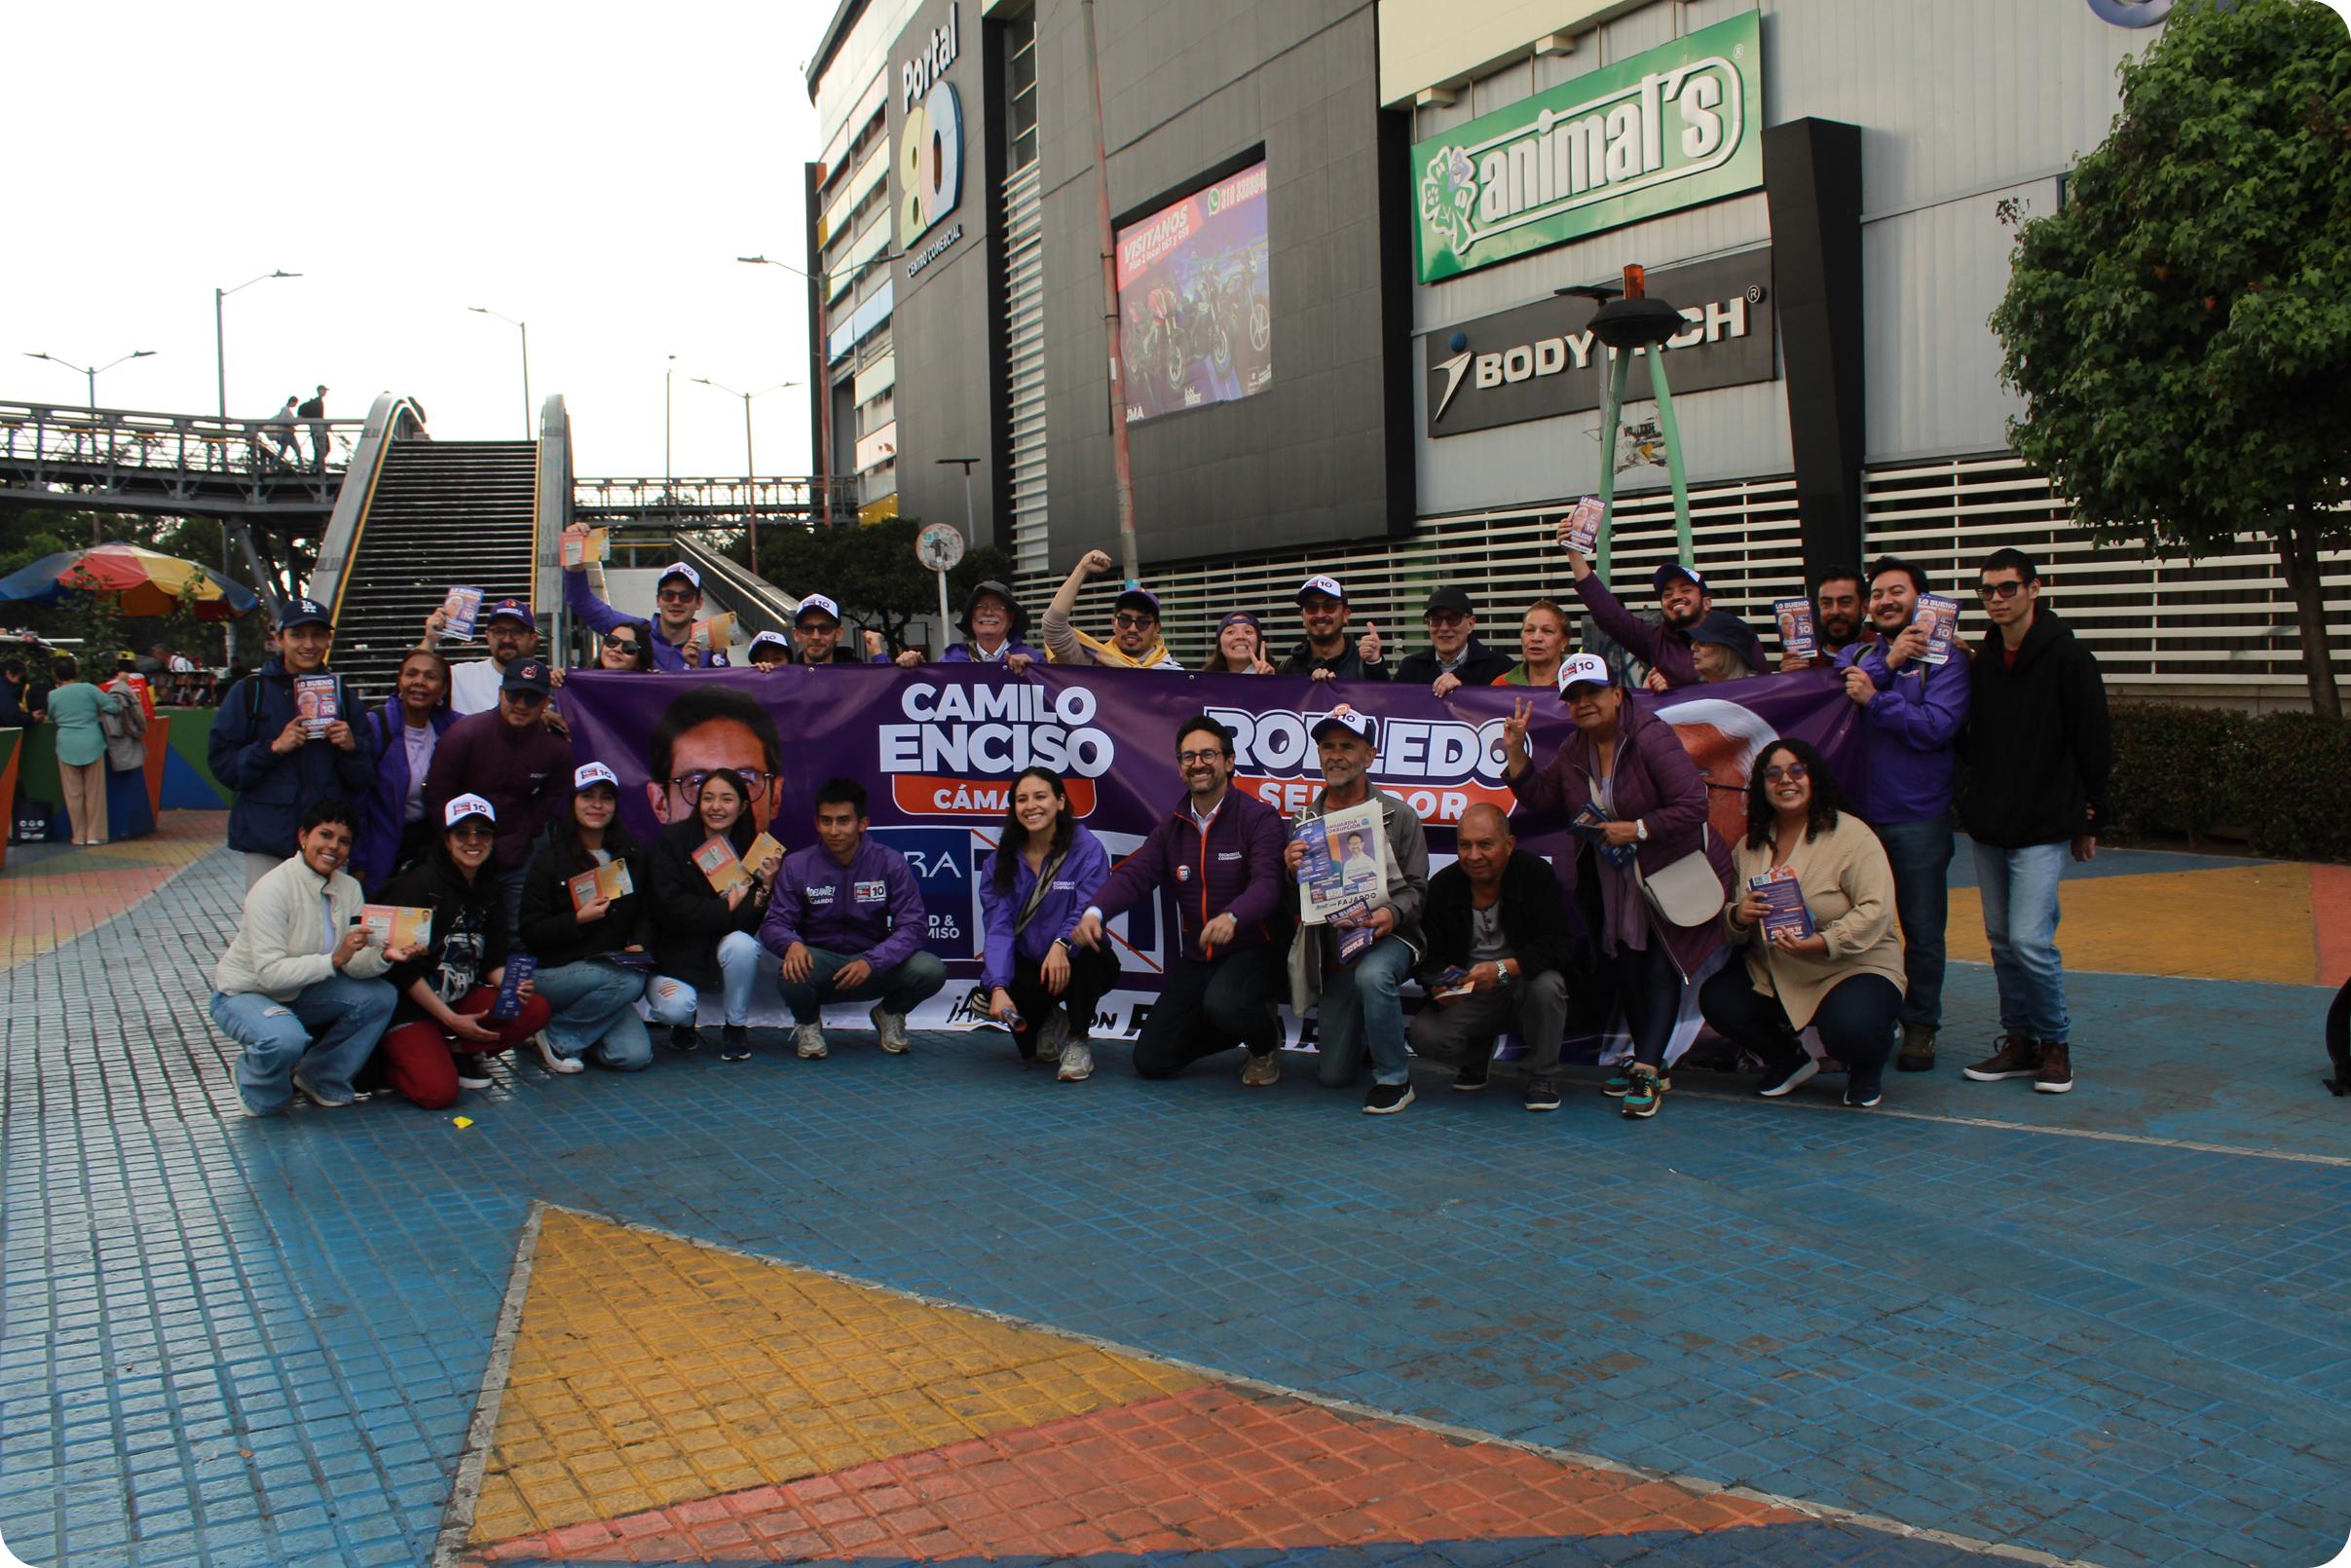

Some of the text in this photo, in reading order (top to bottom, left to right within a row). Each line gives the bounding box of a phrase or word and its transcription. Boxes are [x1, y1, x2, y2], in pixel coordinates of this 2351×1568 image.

[903, 1, 956, 114] Portal
[900, 81, 962, 250] 80
[1479, 73, 1722, 223] animal's
[928, 224, 961, 261] COMERCIAL
[1475, 296, 1746, 389] BODYCH
[1579, 661, 1594, 671] 10
[901, 682, 1097, 726] CAMILO
[878, 723, 1115, 778] ENCISO
[473, 803, 487, 813] 10
[934, 784, 1011, 810] CÁMA
[872, 885, 884, 896] 10
